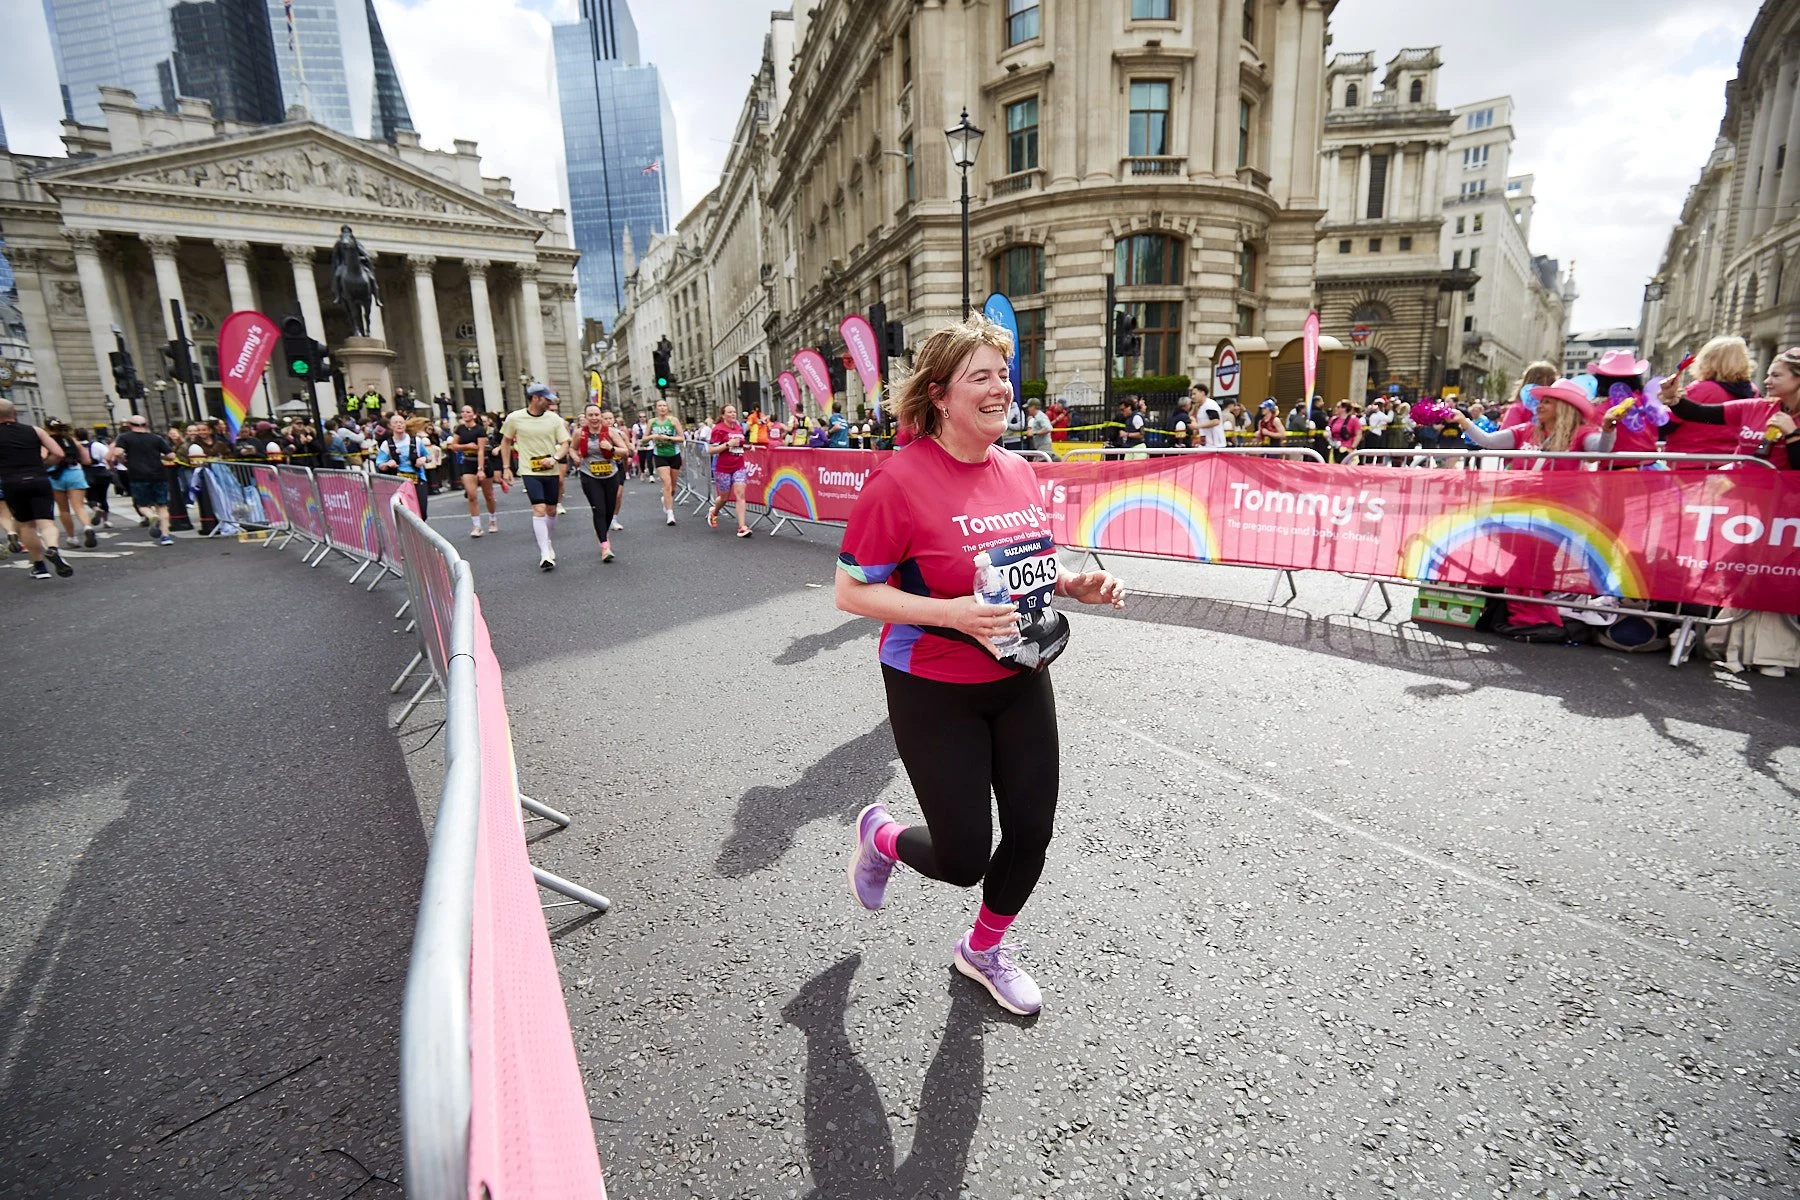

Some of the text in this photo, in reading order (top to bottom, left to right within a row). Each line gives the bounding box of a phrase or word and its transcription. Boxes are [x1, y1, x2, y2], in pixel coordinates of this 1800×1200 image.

[229, 324, 262, 379] Tommy's
[818, 466, 870, 491] Tommy'
[1230, 482, 1387, 526] Tommy's
[952, 503, 1047, 537] Tommy's
[1227, 518, 1381, 545] The pregnancy and baby charity
[962, 544, 977, 553] The
[977, 536, 1013, 550] pregnancy
[1013, 532, 1026, 541] and
[1025, 530, 1042, 539] baby
[1676, 555, 1710, 570] The
